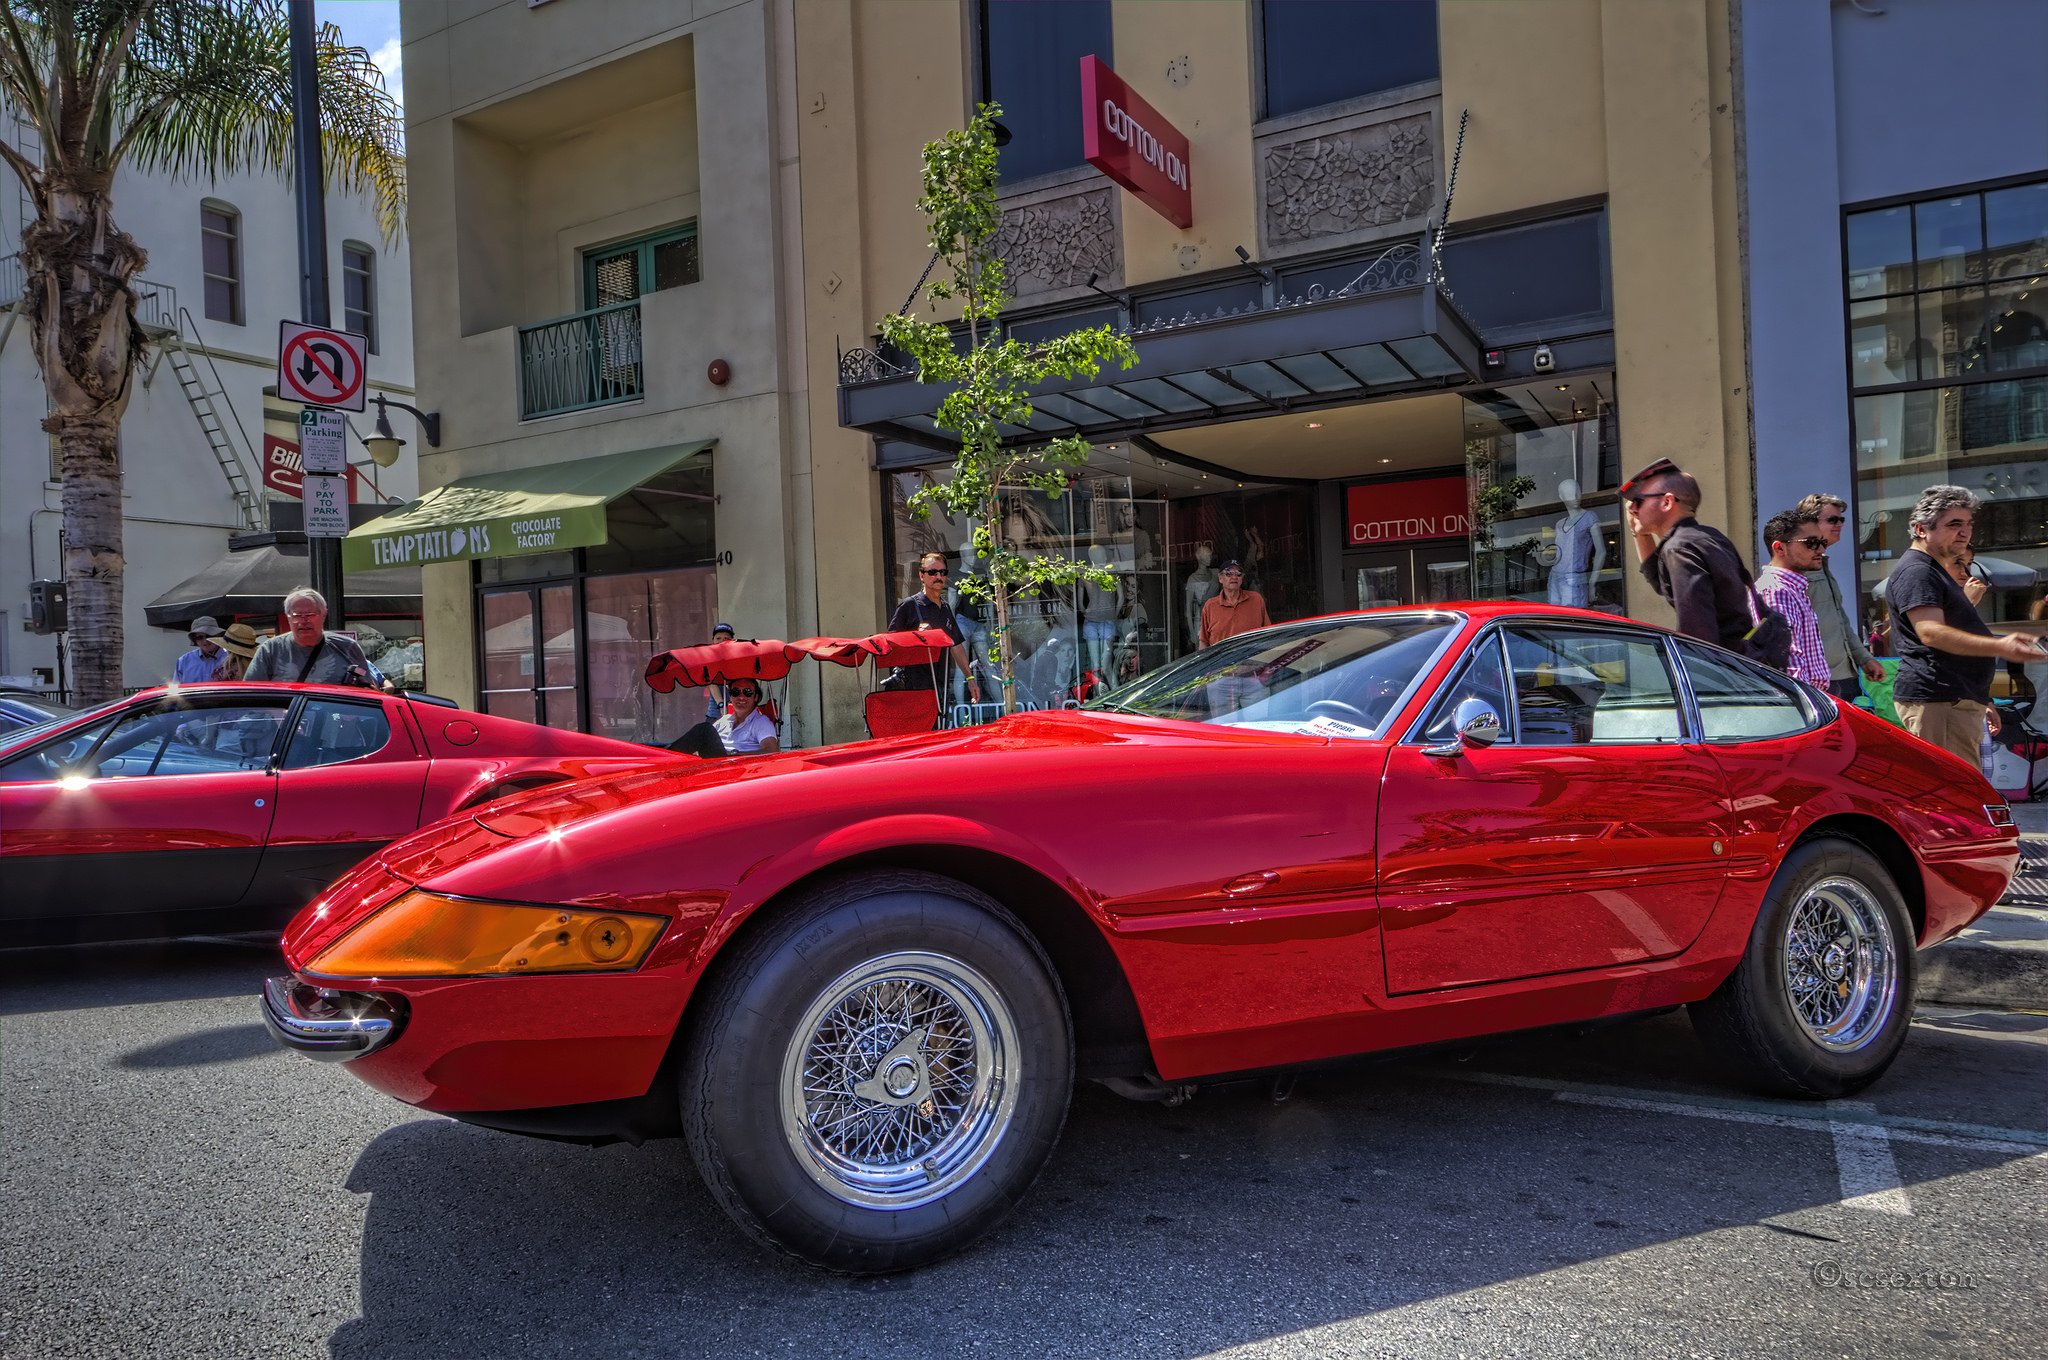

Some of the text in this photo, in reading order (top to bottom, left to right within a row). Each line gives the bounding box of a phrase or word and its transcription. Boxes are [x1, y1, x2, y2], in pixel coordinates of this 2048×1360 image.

[1104, 99, 1187, 191] COTTON ON
[304, 411, 342, 425] 2 Hour
[305, 426, 343, 439] Parking
[316, 491, 335, 499] PAY
[320, 499, 333, 507] TO
[313, 507, 339, 515] PARK
[511, 516, 561, 535] CHOCOLATE
[1353, 514, 1471, 541] COTTON ON
[517, 531, 557, 549] FACTORY
[716, 550, 733, 567] 40
[1328, 721, 1356, 733] Please
